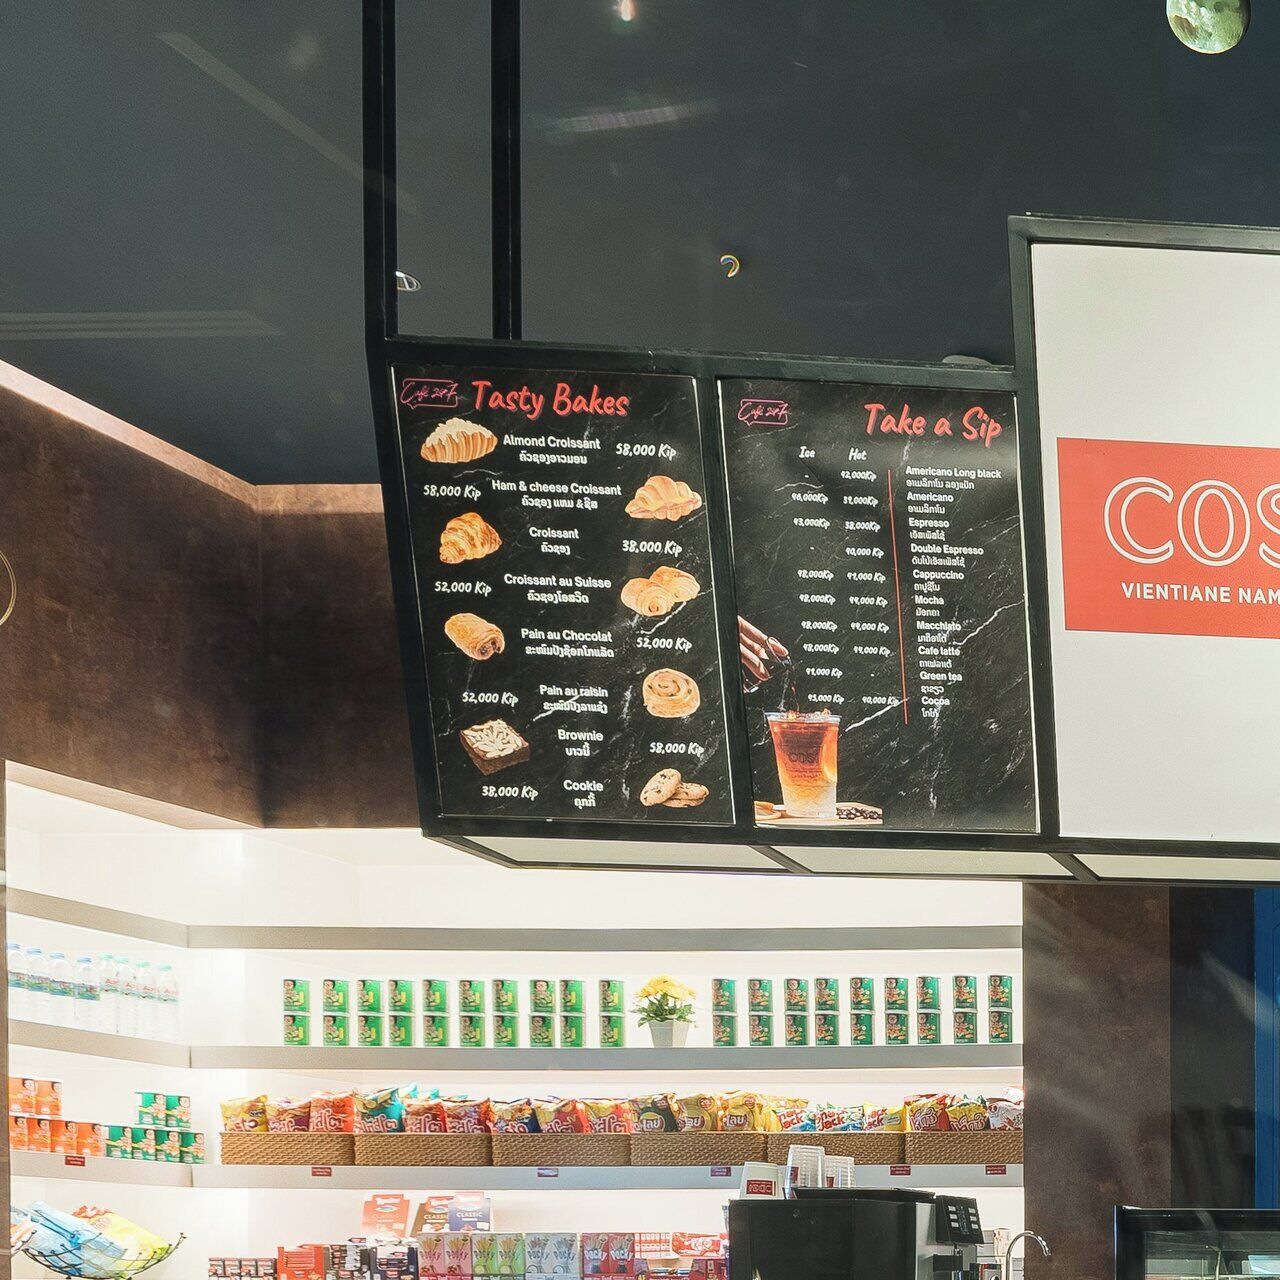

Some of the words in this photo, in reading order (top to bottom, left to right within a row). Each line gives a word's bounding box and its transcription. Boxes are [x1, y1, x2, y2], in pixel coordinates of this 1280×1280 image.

[472, 381, 544, 420] Tasty
[553, 382, 630, 416] Bakes
[864, 404, 926, 436] Take
[934, 416, 952, 436] a
[963, 406, 1002, 448] Sip
[503, 435, 545, 446] Almond
[548, 436, 600, 449] Croissant
[616, 443, 655, 456] 58,000
[658, 444, 676, 461] Kip
[799, 446, 815, 458] Ice
[849, 448, 866, 460] Hot
[906, 466, 952, 476] Americano
[954, 468, 975, 479] Long
[977, 469, 1001, 478] black
[424, 485, 461, 497] 58,000
[464, 485, 481, 501] Kip
[492, 480, 516, 490] Ham
[519, 481, 527, 491] &
[530, 482, 568, 493] cheese
[570, 483, 621, 495] Croissant
[907, 492, 953, 502] Americano
[909, 518, 949, 528] Espresso
[529, 527, 579, 538] Croissant
[623, 540, 661, 553] 38,000
[664, 541, 682, 557] Kip
[911, 543, 942, 553] Double
[943, 545, 984, 555] Espresso
[504, 574, 557, 586] Croissant
[559, 578, 572, 586] au
[575, 576, 611, 588] Suisse
[913, 570, 964, 580] Cappuccino
[1120, 582, 1231, 602] VIENTIANE
[915, 595, 944, 604] Mocha
[917, 621, 961, 633] Macchiato
[521, 629, 545, 639] Pain
[562, 630, 612, 642] Chocolat
[918, 646, 939, 655] Cafe
[940, 647, 961, 656] latte
[920, 671, 947, 680] Green
[948, 672, 962, 683] tea
[540, 685, 563, 695] Pain
[565, 688, 578, 698] au
[579, 687, 608, 697] raisin
[922, 696, 950, 708] Cocoa
[558, 729, 603, 741] Brownie
[564, 780, 603, 791] Cookie
